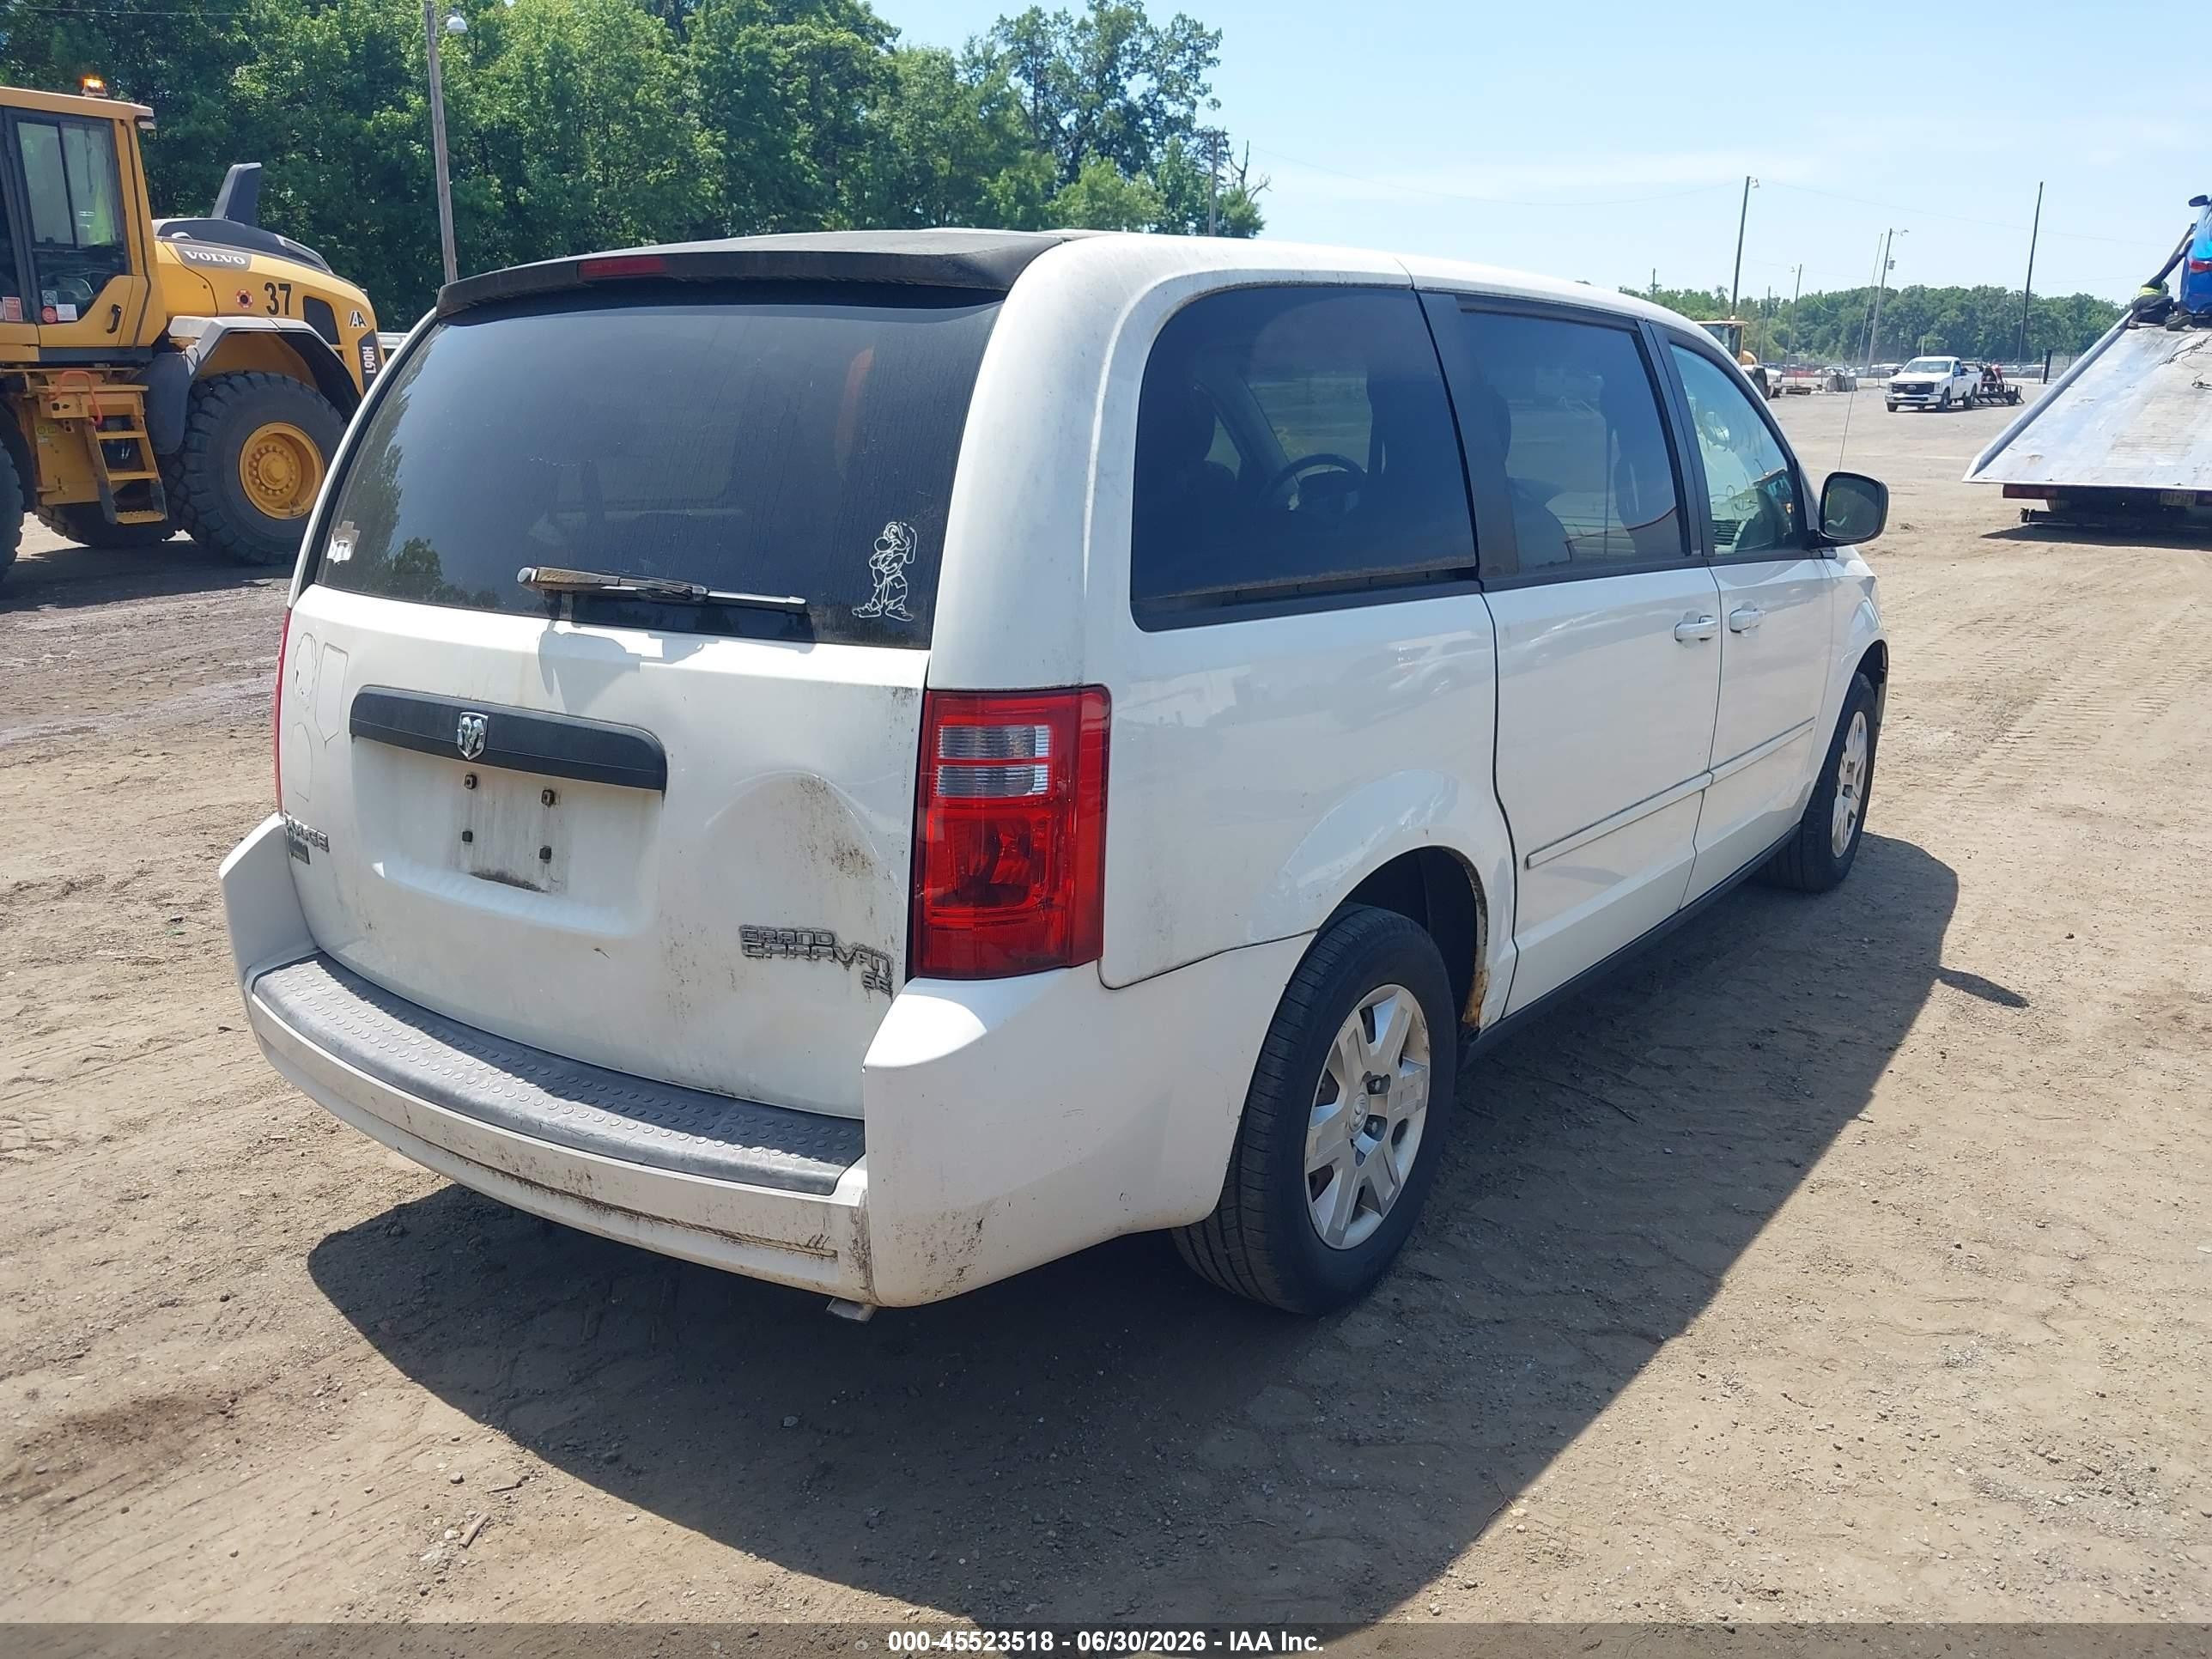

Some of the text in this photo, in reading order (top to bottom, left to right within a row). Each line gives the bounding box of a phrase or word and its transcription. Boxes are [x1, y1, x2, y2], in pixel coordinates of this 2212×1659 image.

[184, 250, 246, 264] VOLVO
[264, 282, 292, 316] 37
[362, 346, 377, 374] L90H
[740, 926, 836, 945] GRAND
[741, 941, 893, 974] CARAVAN
[862, 970, 893, 995] SE
